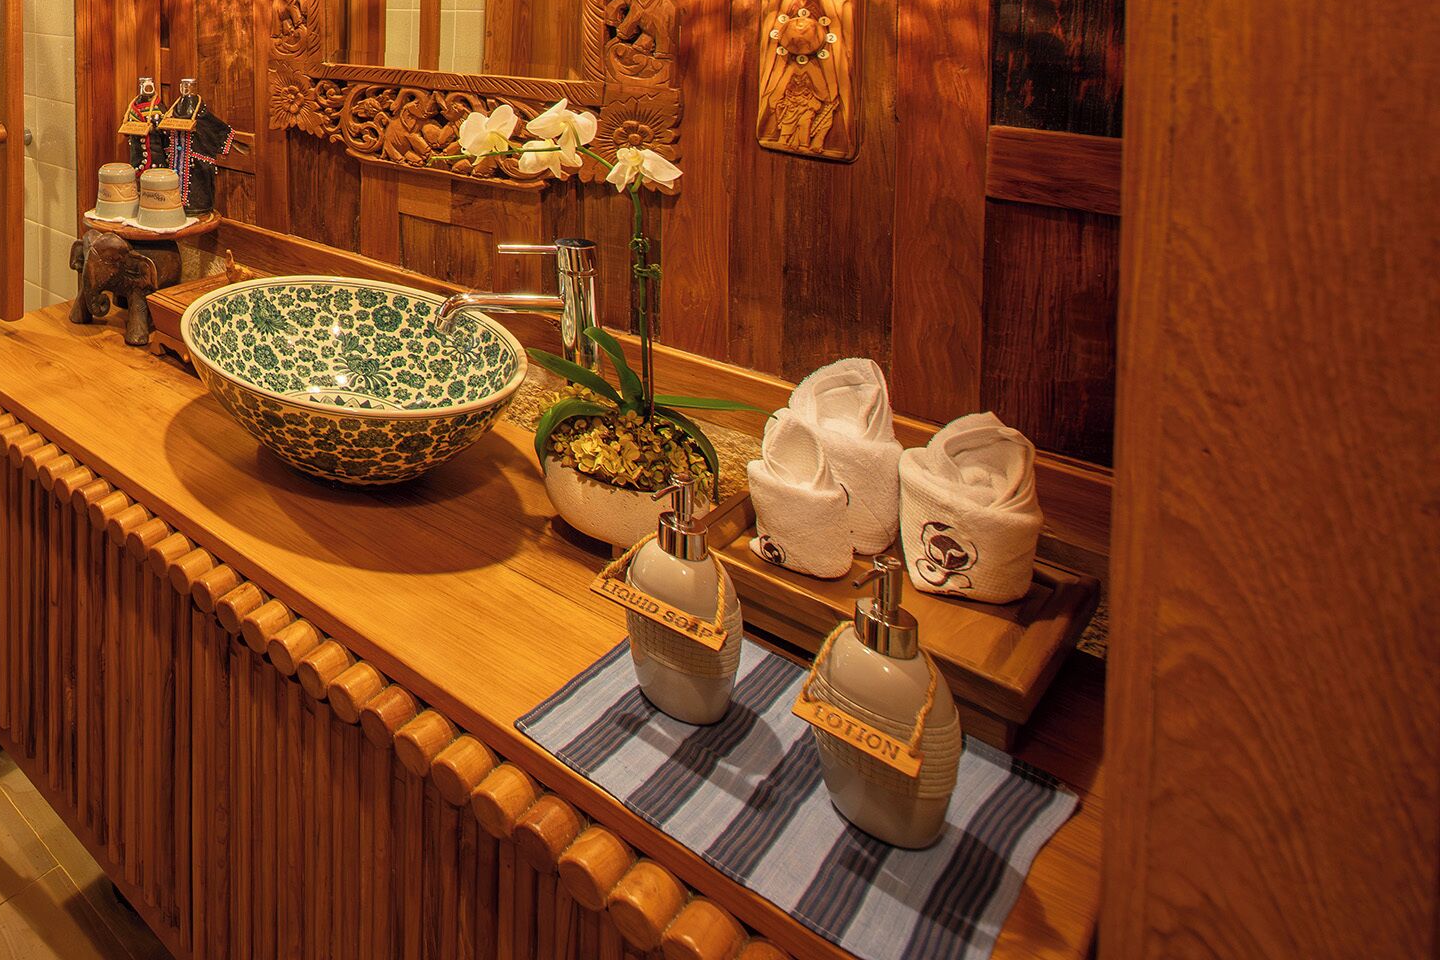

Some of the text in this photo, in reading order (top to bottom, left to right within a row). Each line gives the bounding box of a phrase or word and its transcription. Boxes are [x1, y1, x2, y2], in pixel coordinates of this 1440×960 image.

[601, 580, 713, 638] LIQUID SOAP
[814, 705, 900, 760] LOTION
